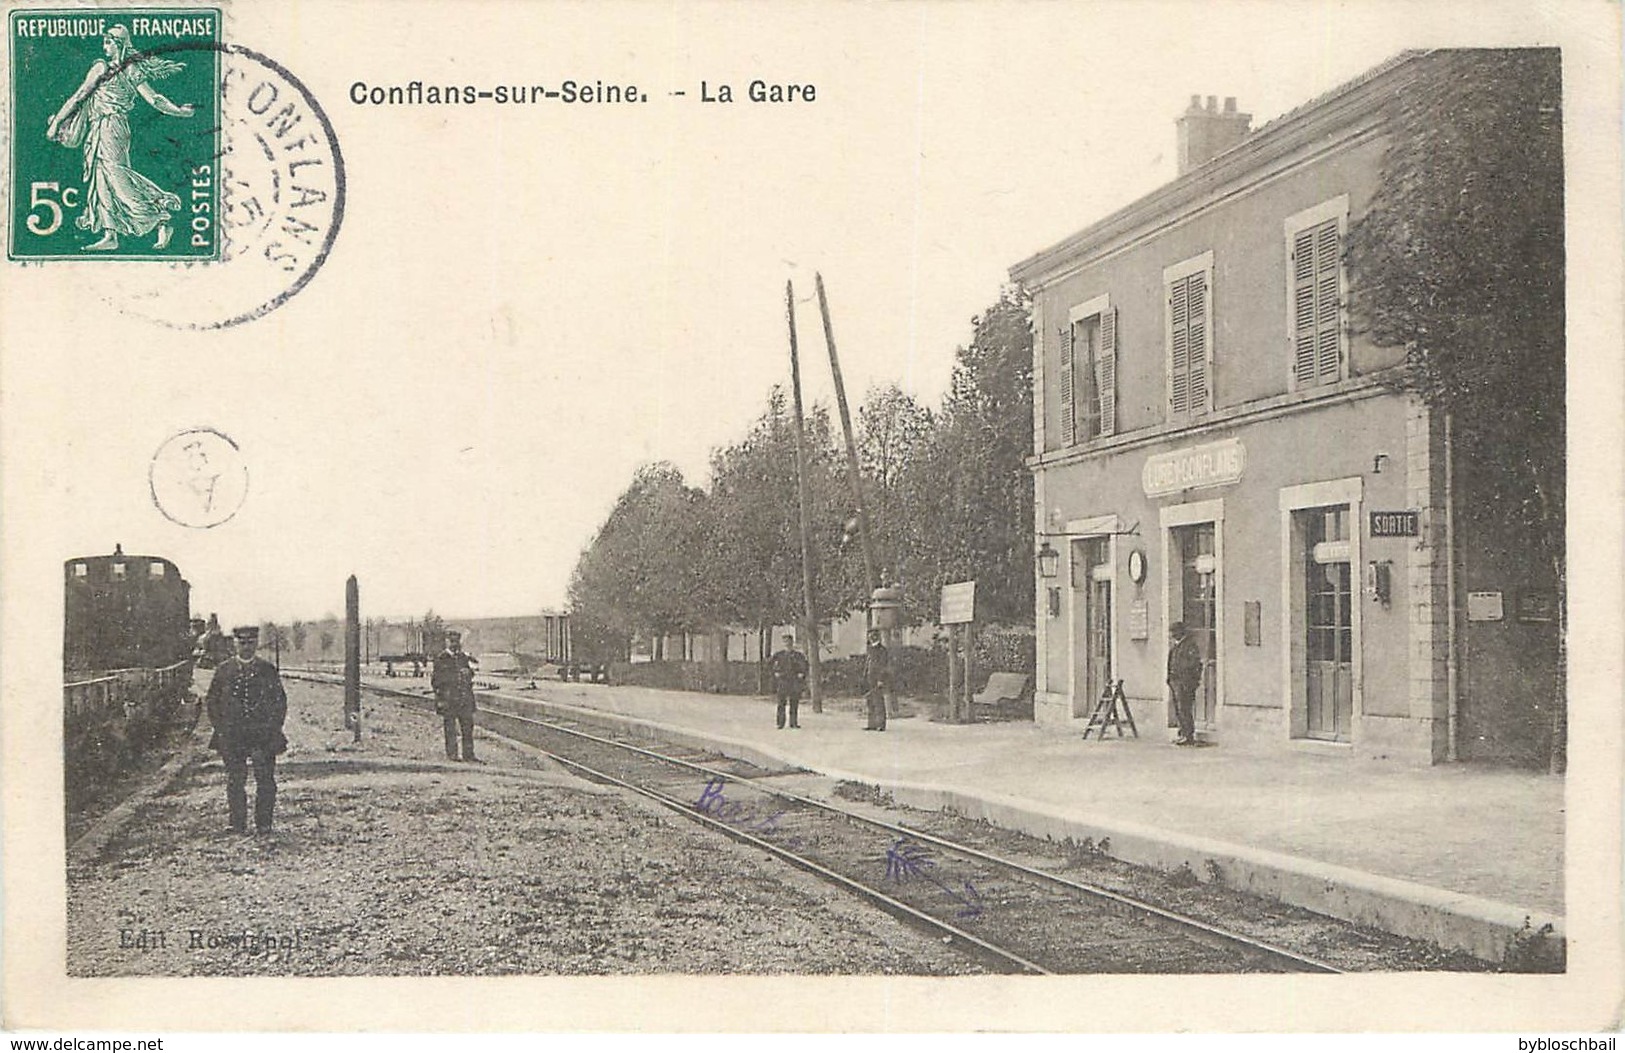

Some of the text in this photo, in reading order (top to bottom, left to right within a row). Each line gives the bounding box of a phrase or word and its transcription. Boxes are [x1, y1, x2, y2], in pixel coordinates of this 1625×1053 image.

[132, 17, 213, 38] FRANÇAISE
[221, 66, 328, 272] CONFLANS
[191, 164, 211, 247] POSTES
[1374, 515, 1414, 534] SORTIE
